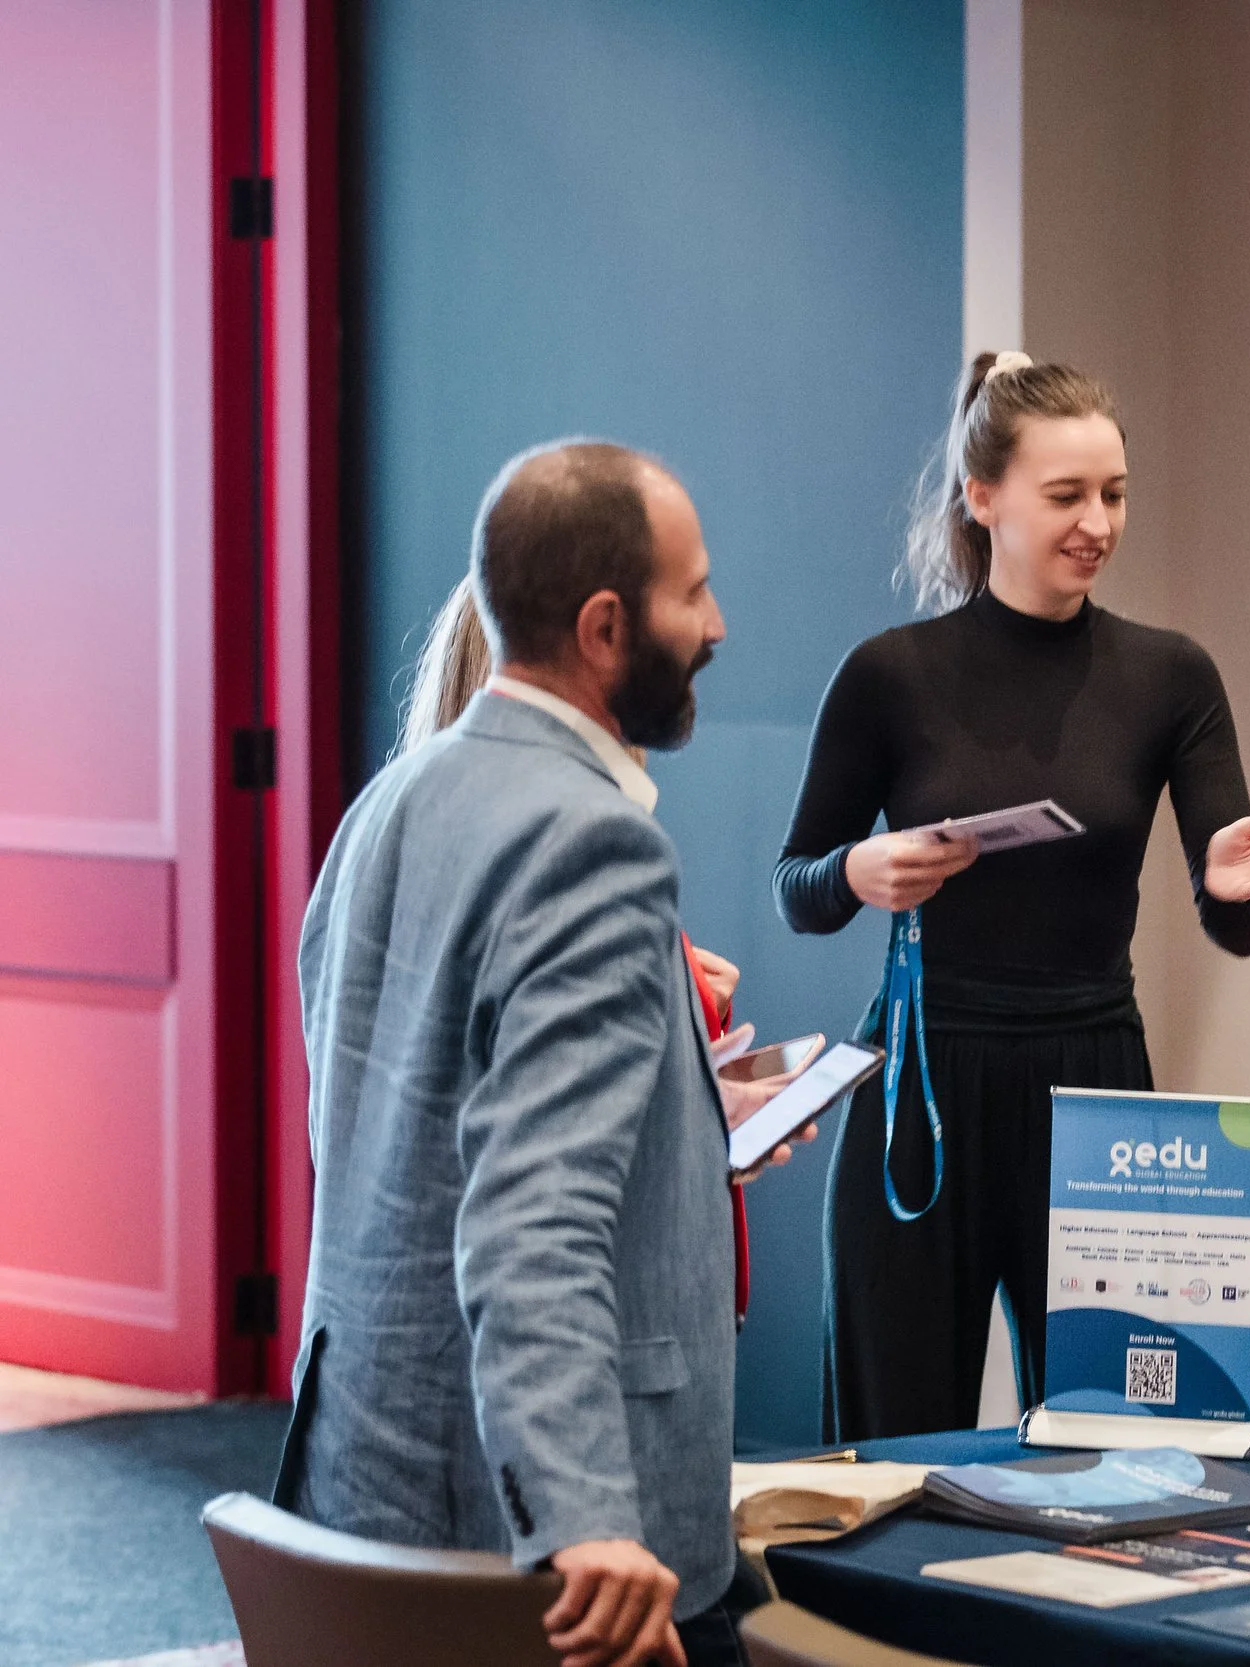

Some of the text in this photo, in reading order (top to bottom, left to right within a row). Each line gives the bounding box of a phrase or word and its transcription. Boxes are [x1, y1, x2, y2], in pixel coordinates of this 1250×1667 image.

[1110, 1136, 1207, 1178] gedu
[1165, 1171, 1207, 1181] EDUCATION
[1067, 1179, 1245, 1198] Transforming the world through education
[1059, 1224, 1082, 1234] Higher
[1084, 1225, 1119, 1234] Education
[1126, 1228, 1160, 1238] Language
[1161, 1229, 1188, 1238] Schools
[1129, 1333, 1176, 1346] Enroll Now
